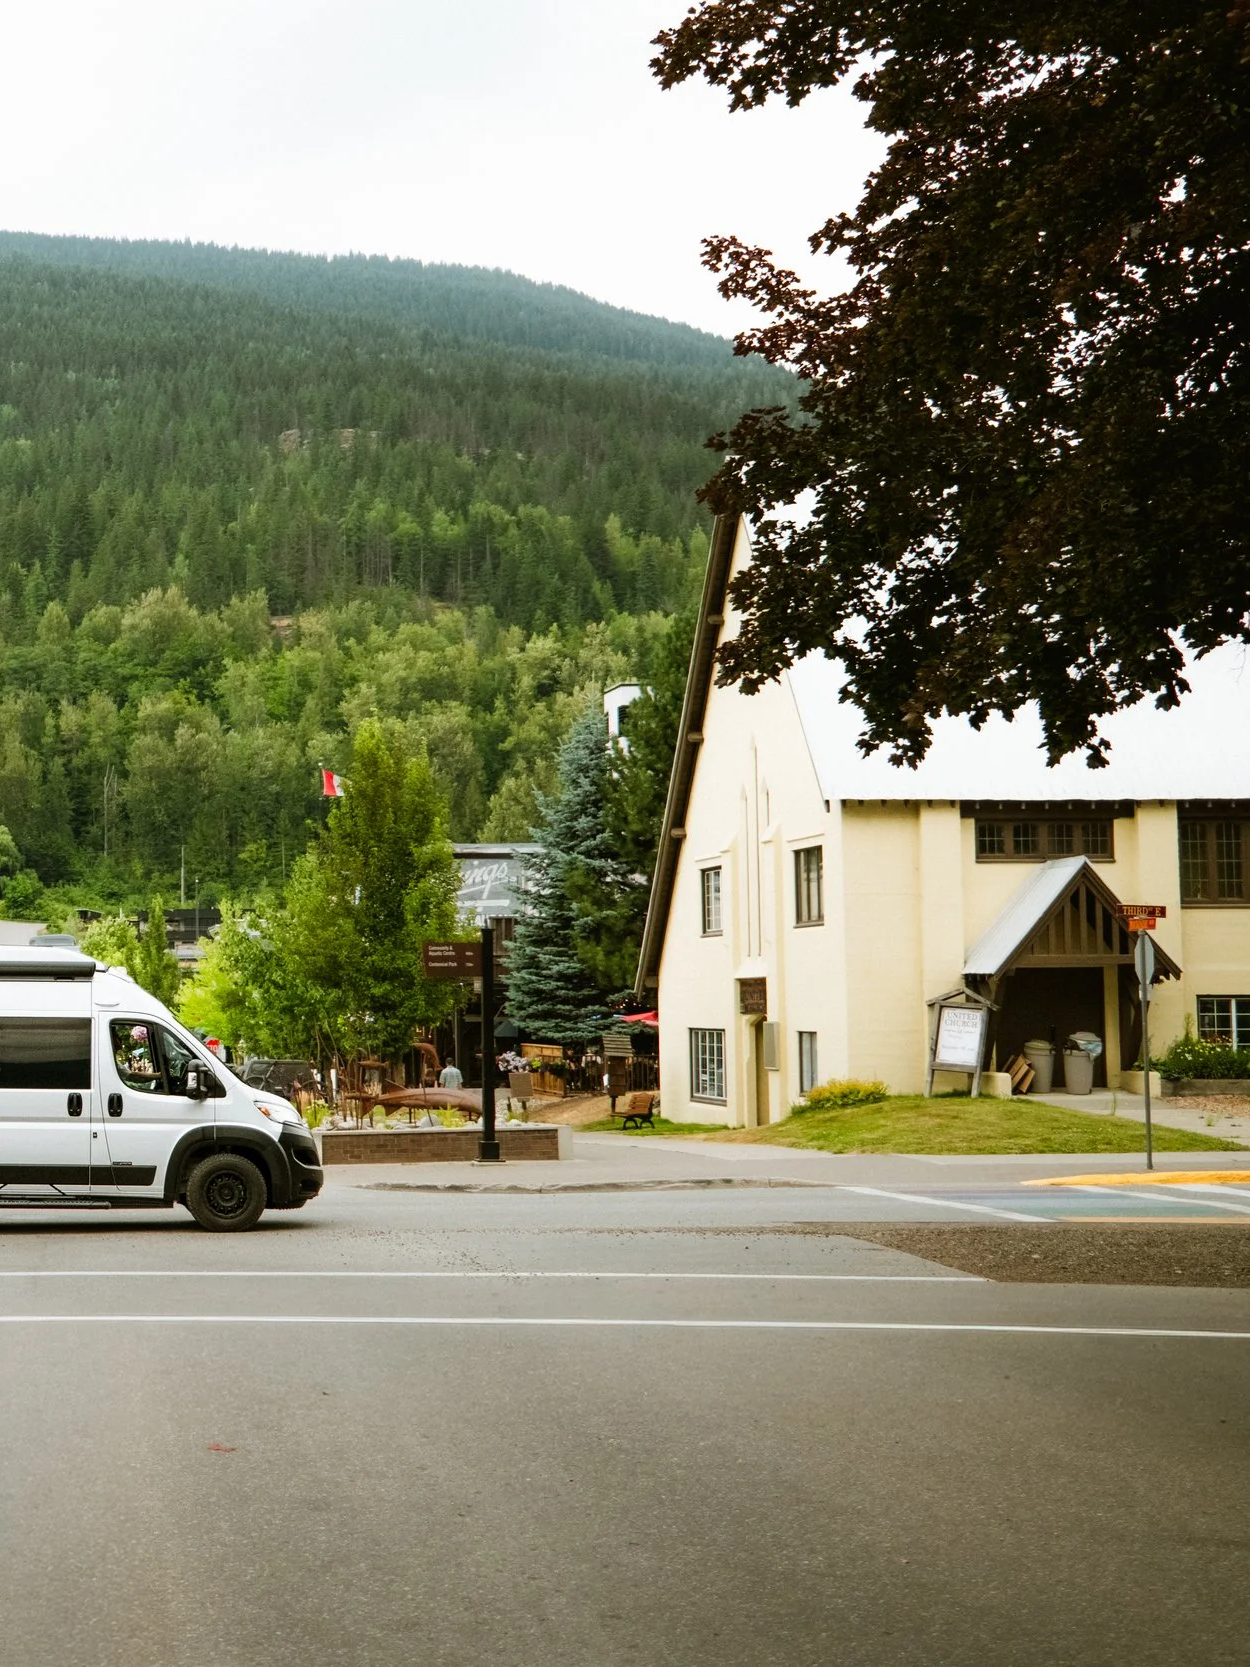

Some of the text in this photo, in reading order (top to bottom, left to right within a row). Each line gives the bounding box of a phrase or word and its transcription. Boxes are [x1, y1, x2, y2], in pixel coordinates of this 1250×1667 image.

[1122, 906, 1149, 916] THIRD
[1155, 907, 1162, 916] E
[947, 1011, 978, 1021] UNITED
[944, 1018, 978, 1029] CHURCH
